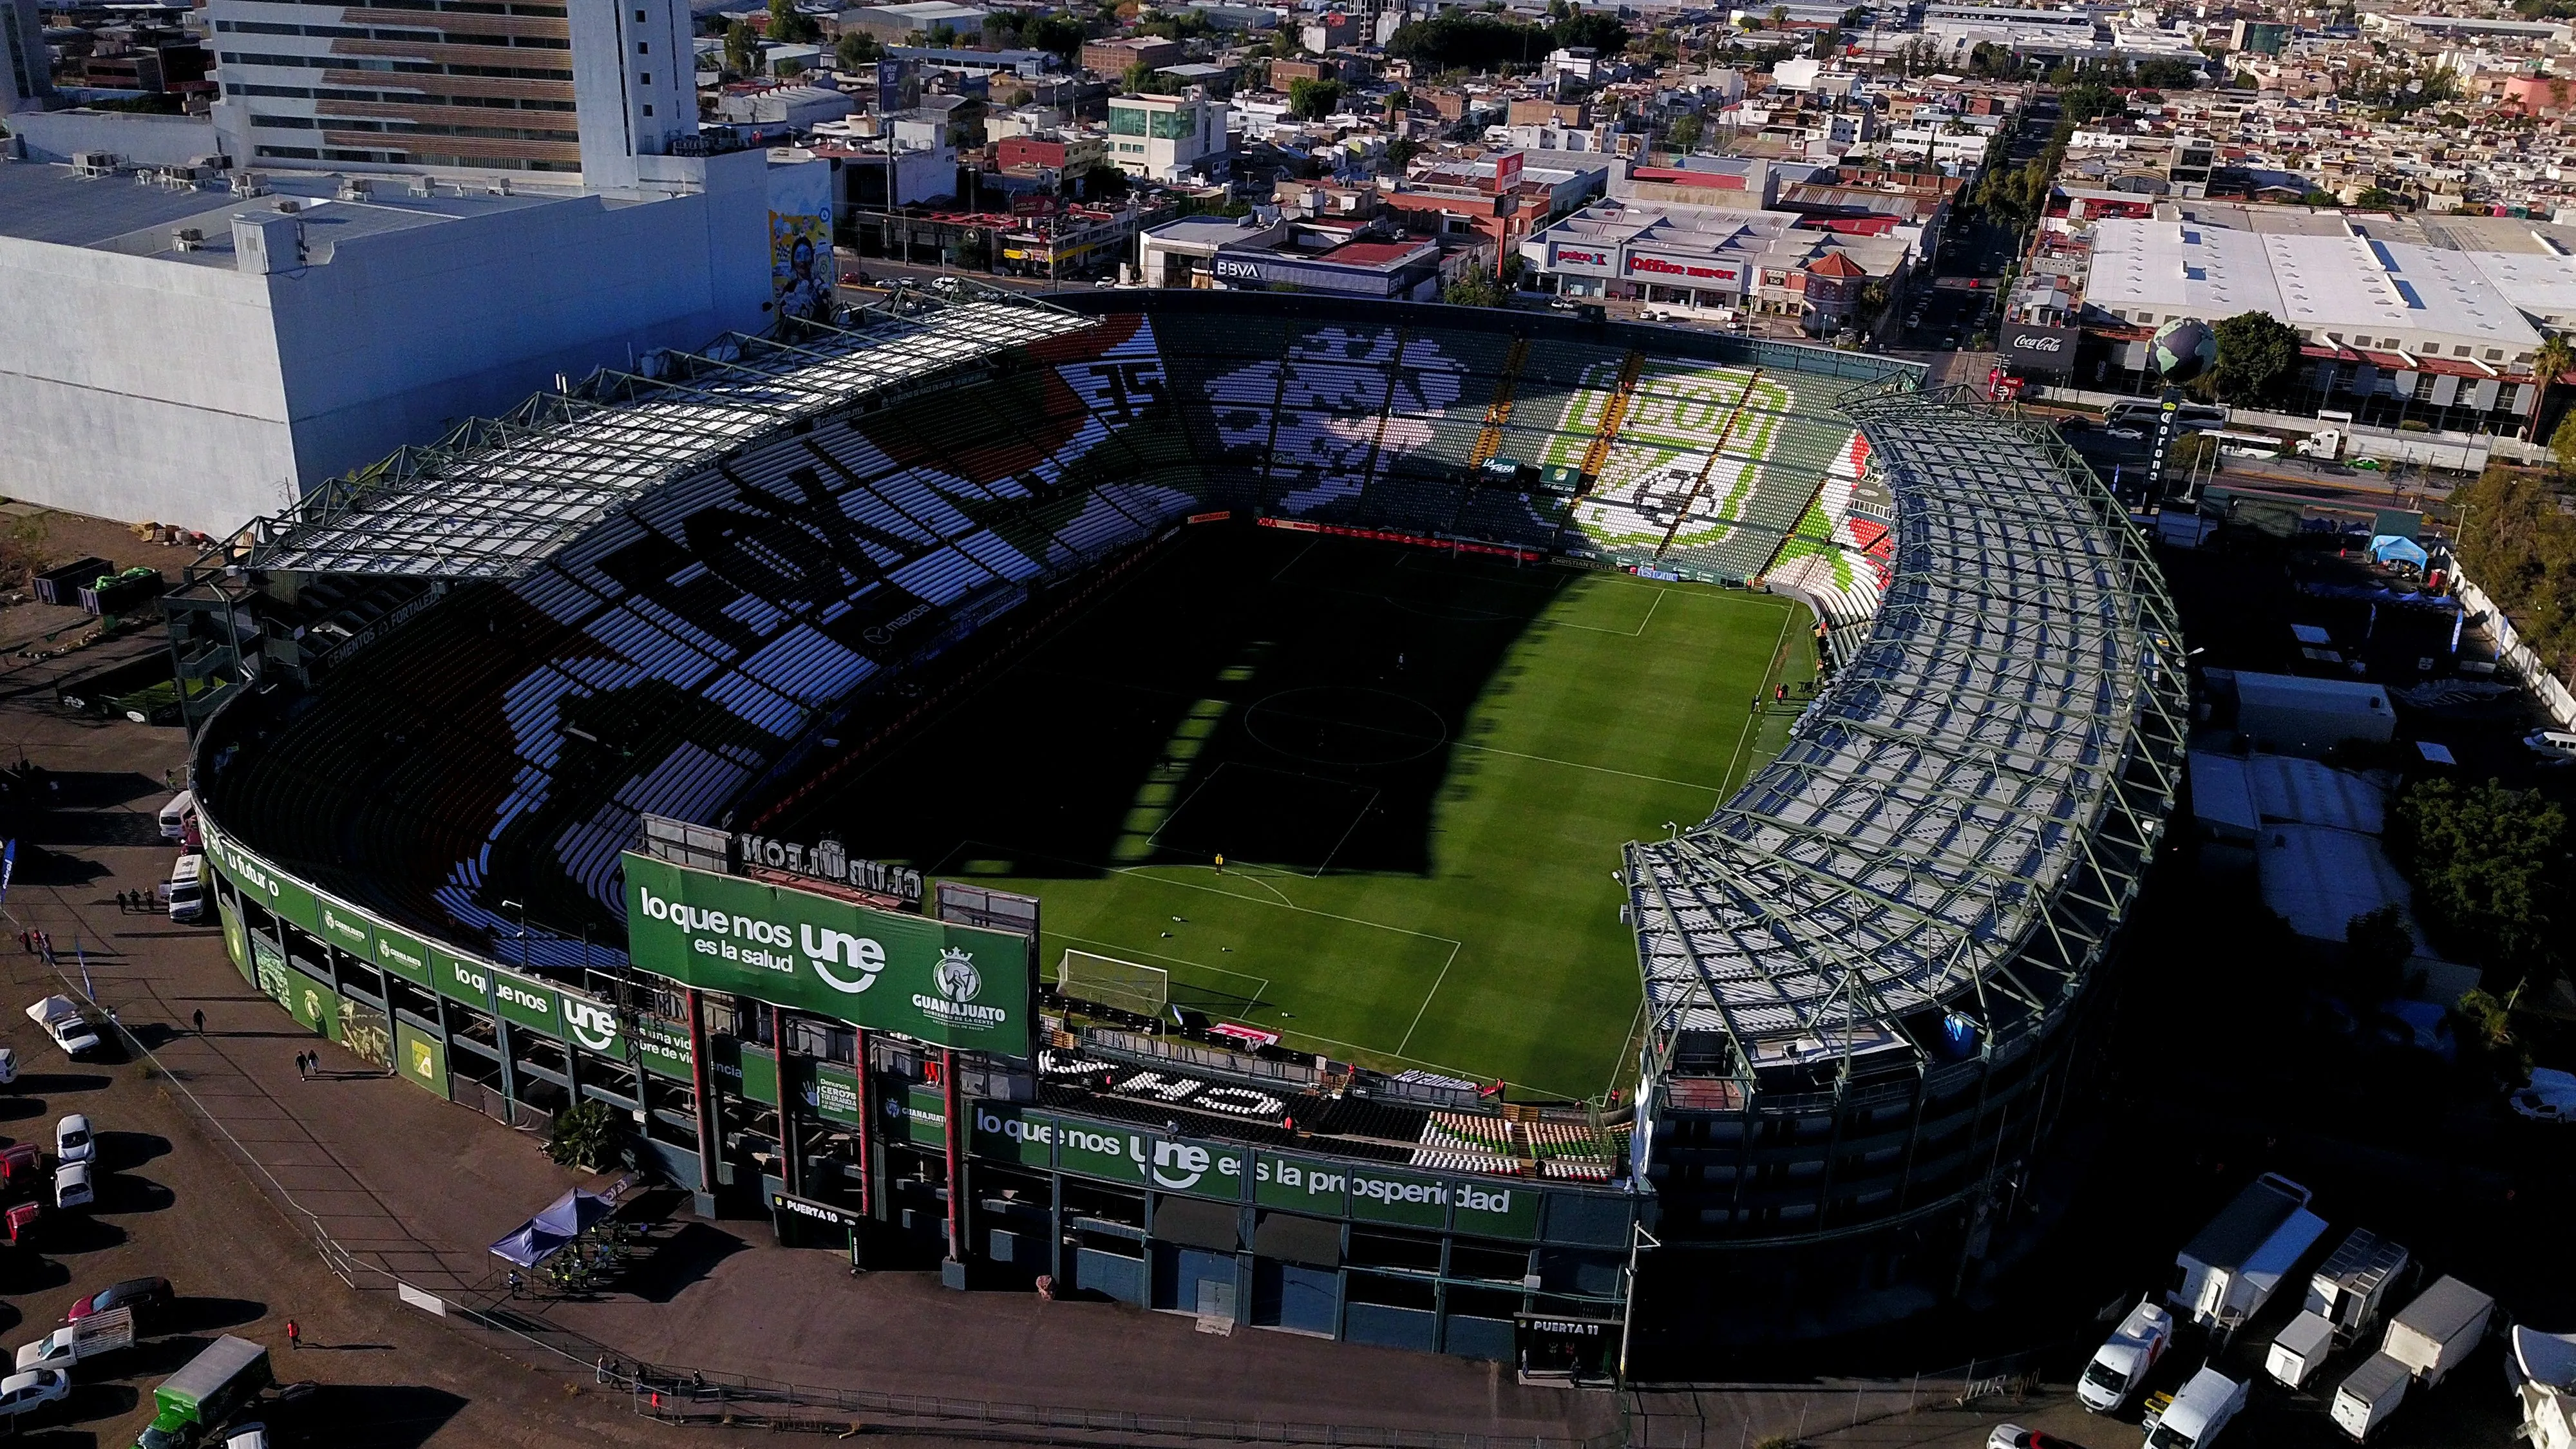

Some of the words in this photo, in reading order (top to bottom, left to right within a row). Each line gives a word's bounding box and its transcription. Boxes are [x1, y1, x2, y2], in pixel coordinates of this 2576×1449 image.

[1217, 261, 1258, 278] BBVA
[1558, 251, 1593, 262] petco
[1629, 257, 1685, 275] Office
[1686, 266, 1738, 281] DEPOT
[2150, 412, 2174, 481] Corona
[886, 603, 932, 632] mazda
[327, 627, 376, 668] CEMENTOS
[641, 886, 668, 920] lo
[670, 902, 729, 934] que
[733, 915, 793, 948] nos
[800, 923, 886, 973] une
[694, 938, 717, 956] es
[721, 940, 738, 961] la
[741, 948, 793, 974] salud
[454, 962, 470, 985] lo
[515, 989, 548, 1014] nos
[564, 998, 618, 1037] une
[912, 994, 1006, 1022] GUANAJUATO
[662, 1046, 677, 1059] de
[820, 1078, 851, 1090] Denuncia
[977, 1108, 1001, 1133] lo
[1005, 1118, 1065, 1145] que
[1068, 1130, 1121, 1155] nos
[1130, 1135, 1211, 1173] une
[1276, 1160, 1302, 1187] la
[1308, 1171, 1511, 1213] prosperidad
[786, 1200, 827, 1220] PUERTA
[826, 1211, 838, 1223] 10
[1533, 1320, 1585, 1335] PUERTA
[1587, 1324, 1599, 1336] 11
